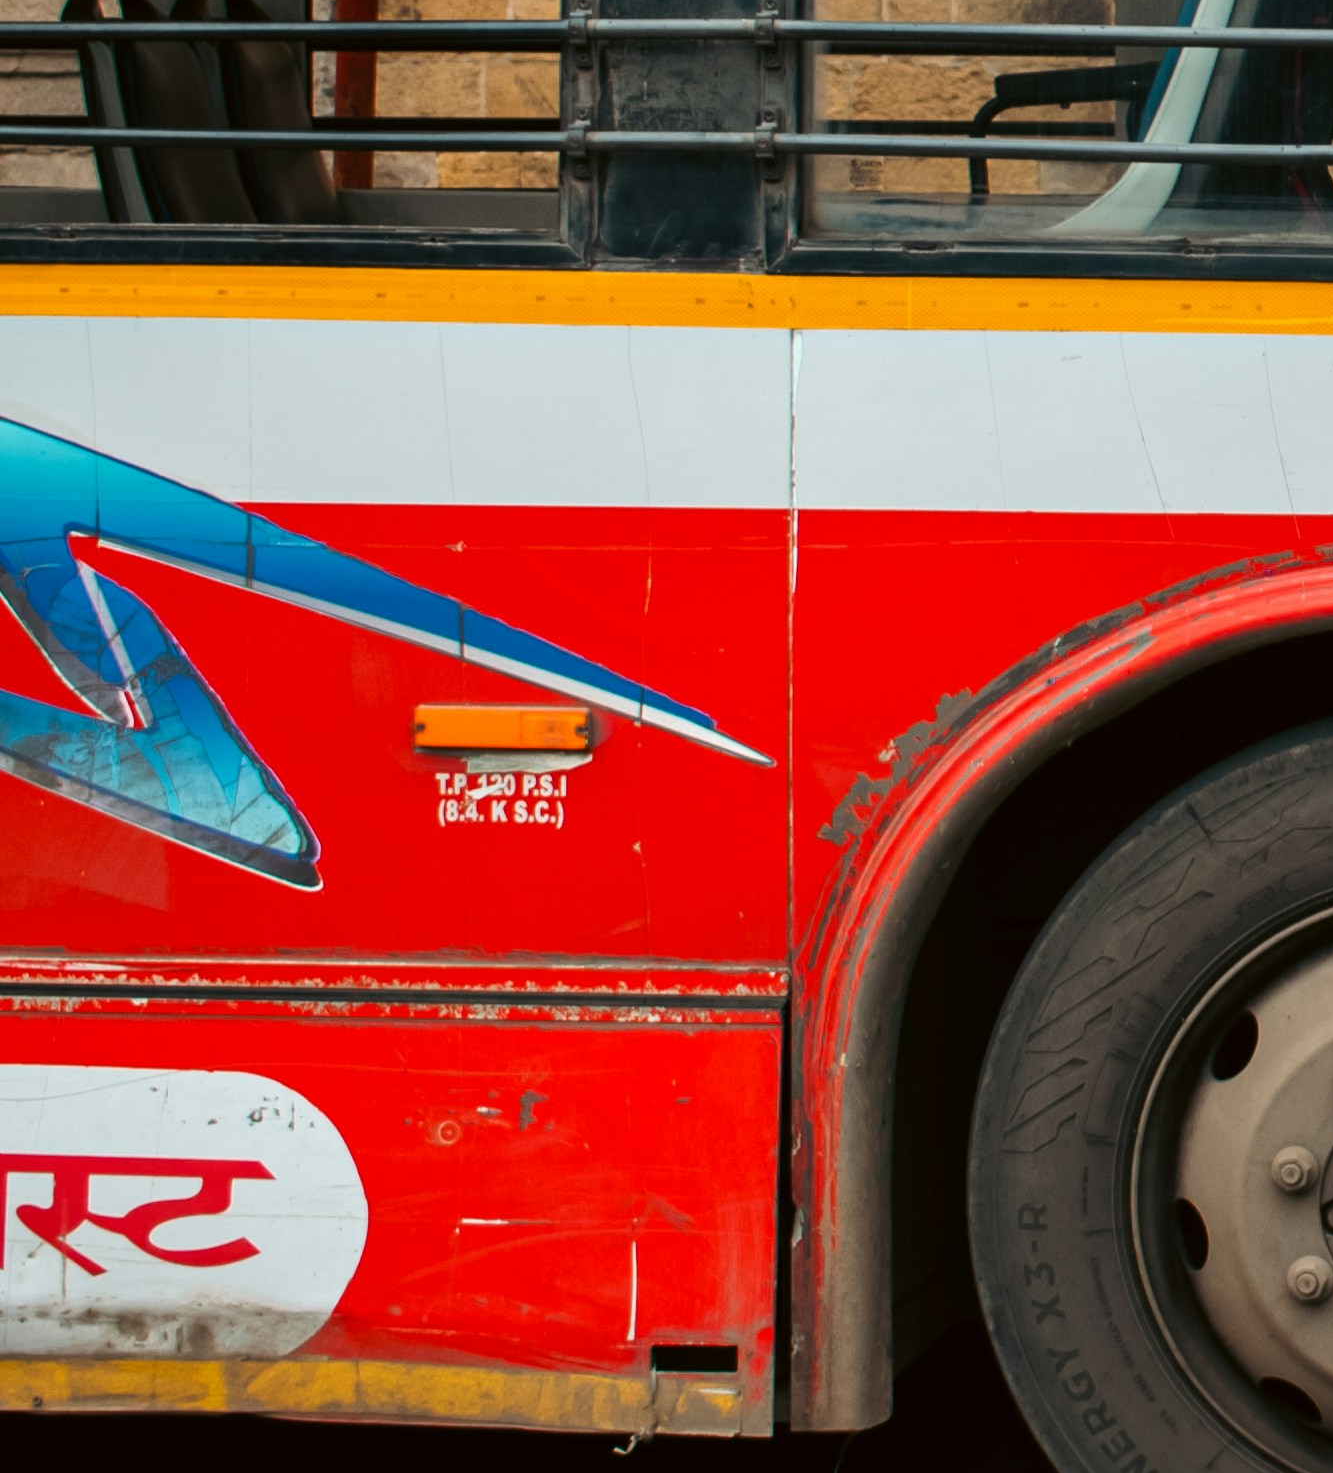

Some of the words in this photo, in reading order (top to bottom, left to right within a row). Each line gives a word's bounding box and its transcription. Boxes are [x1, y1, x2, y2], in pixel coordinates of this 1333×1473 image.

[523, 774, 567, 797] P.S.I
[0, 1154, 276, 1276] स्ट
[1018, 1203, 1066, 1324] X3-R
